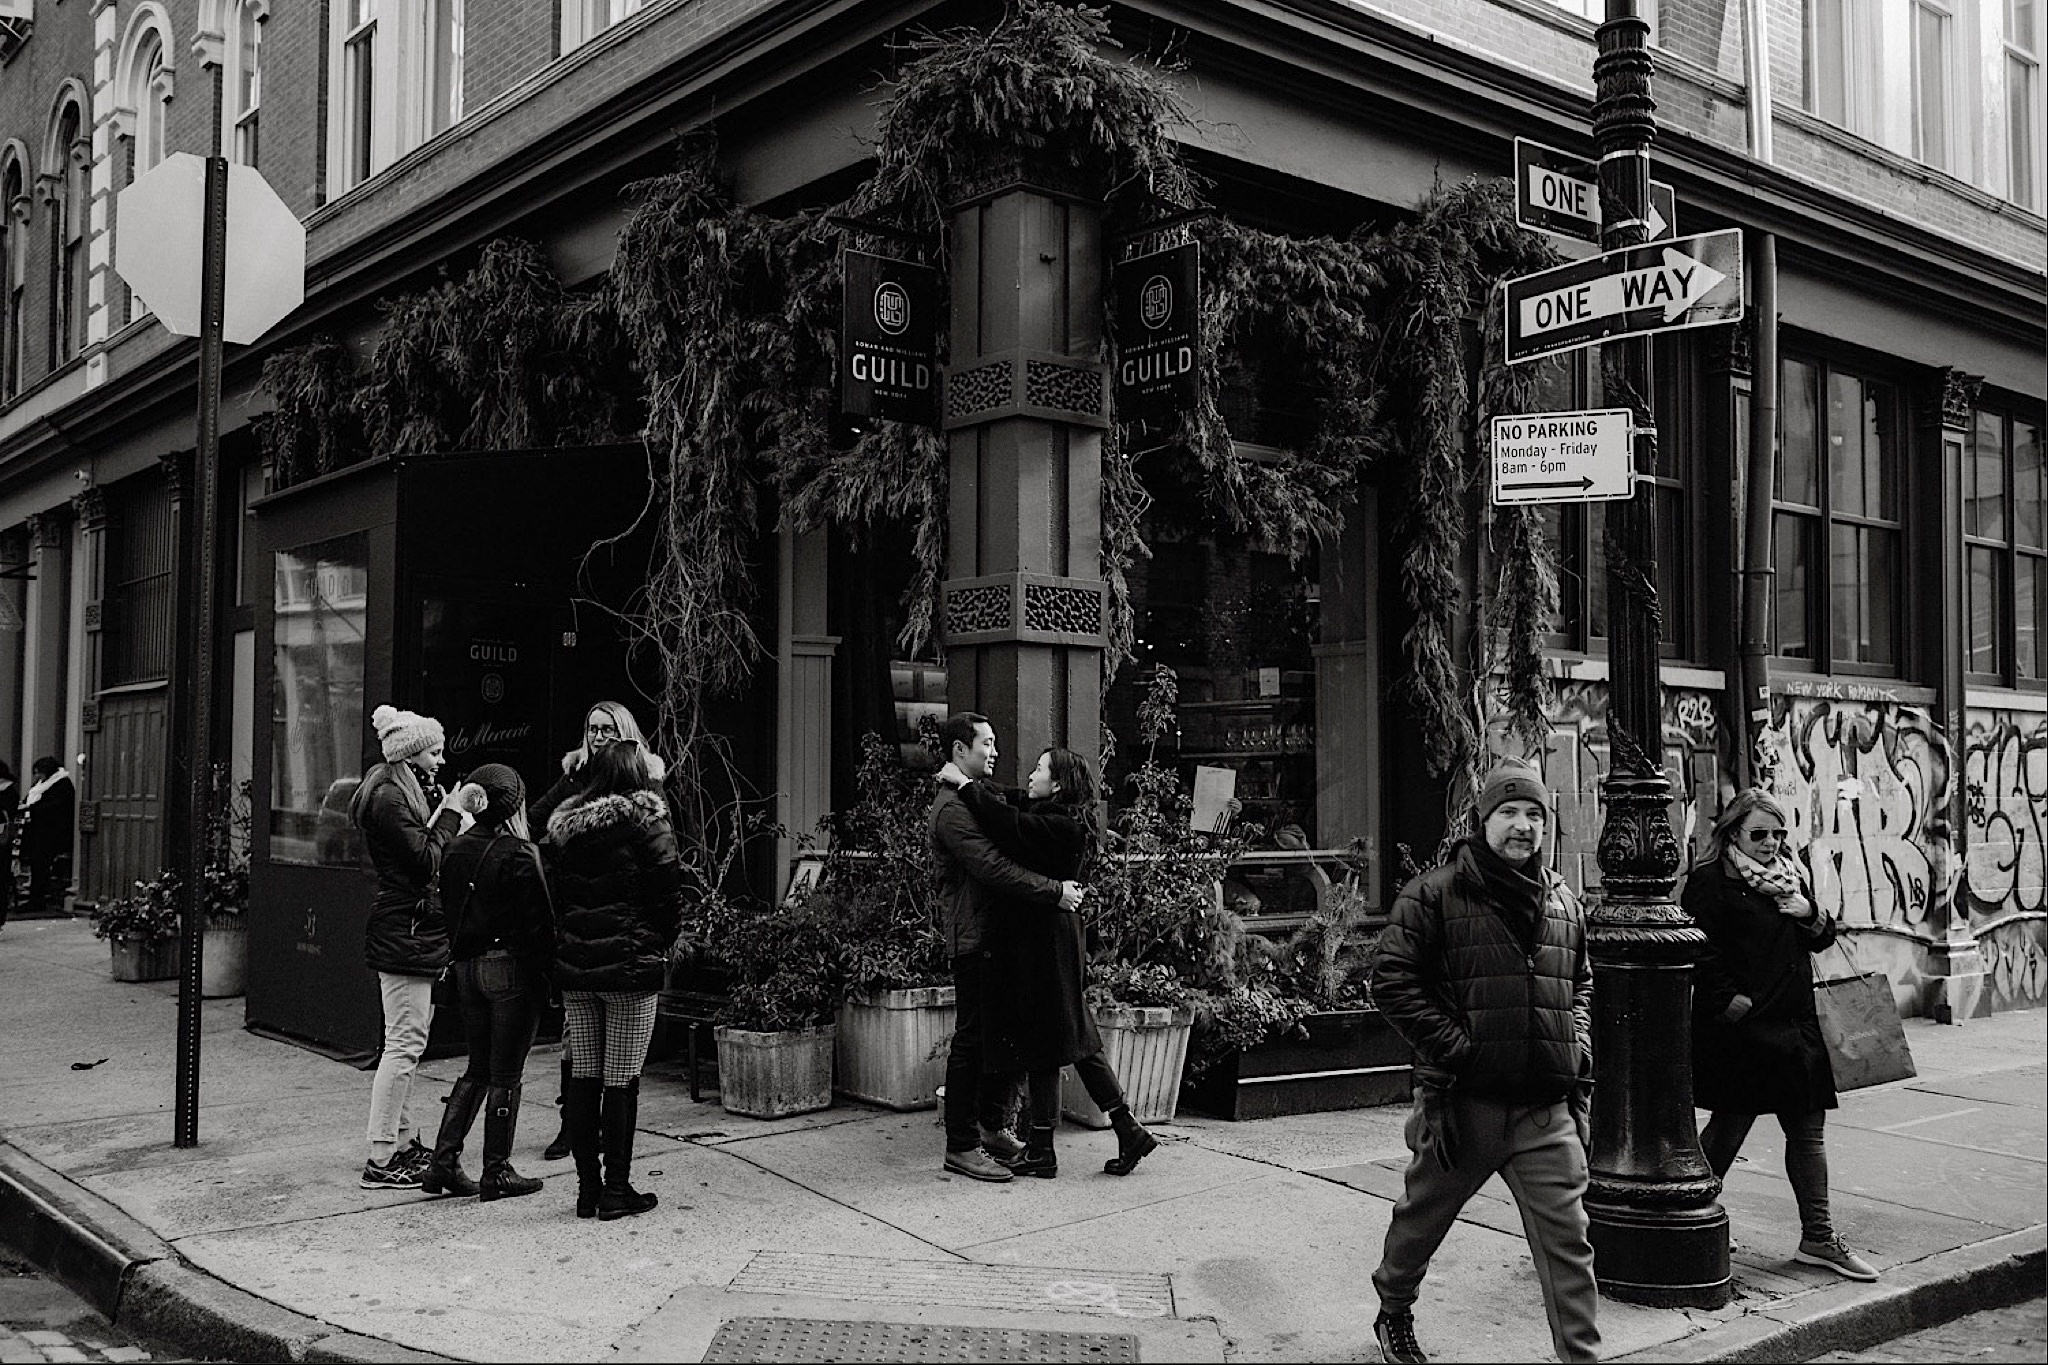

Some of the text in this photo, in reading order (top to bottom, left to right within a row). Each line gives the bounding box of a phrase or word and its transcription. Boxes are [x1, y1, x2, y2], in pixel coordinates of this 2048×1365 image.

[1542, 174, 1587, 216] ONE
[1535, 265, 1696, 328] ONE WAY
[852, 353, 929, 390] GUILD
[1122, 347, 1192, 386] GUILD
[1500, 420, 1598, 440] NO PARKING
[1501, 444, 1547, 458] Monday
[1560, 442, 1598, 456] Friday
[1502, 462, 1528, 474] 8am
[1540, 460, 1566, 474] 6pm
[470, 644, 517, 662] GUILD
[1787, 681, 1812, 695] NEW
[1816, 681, 1843, 699] YORK
